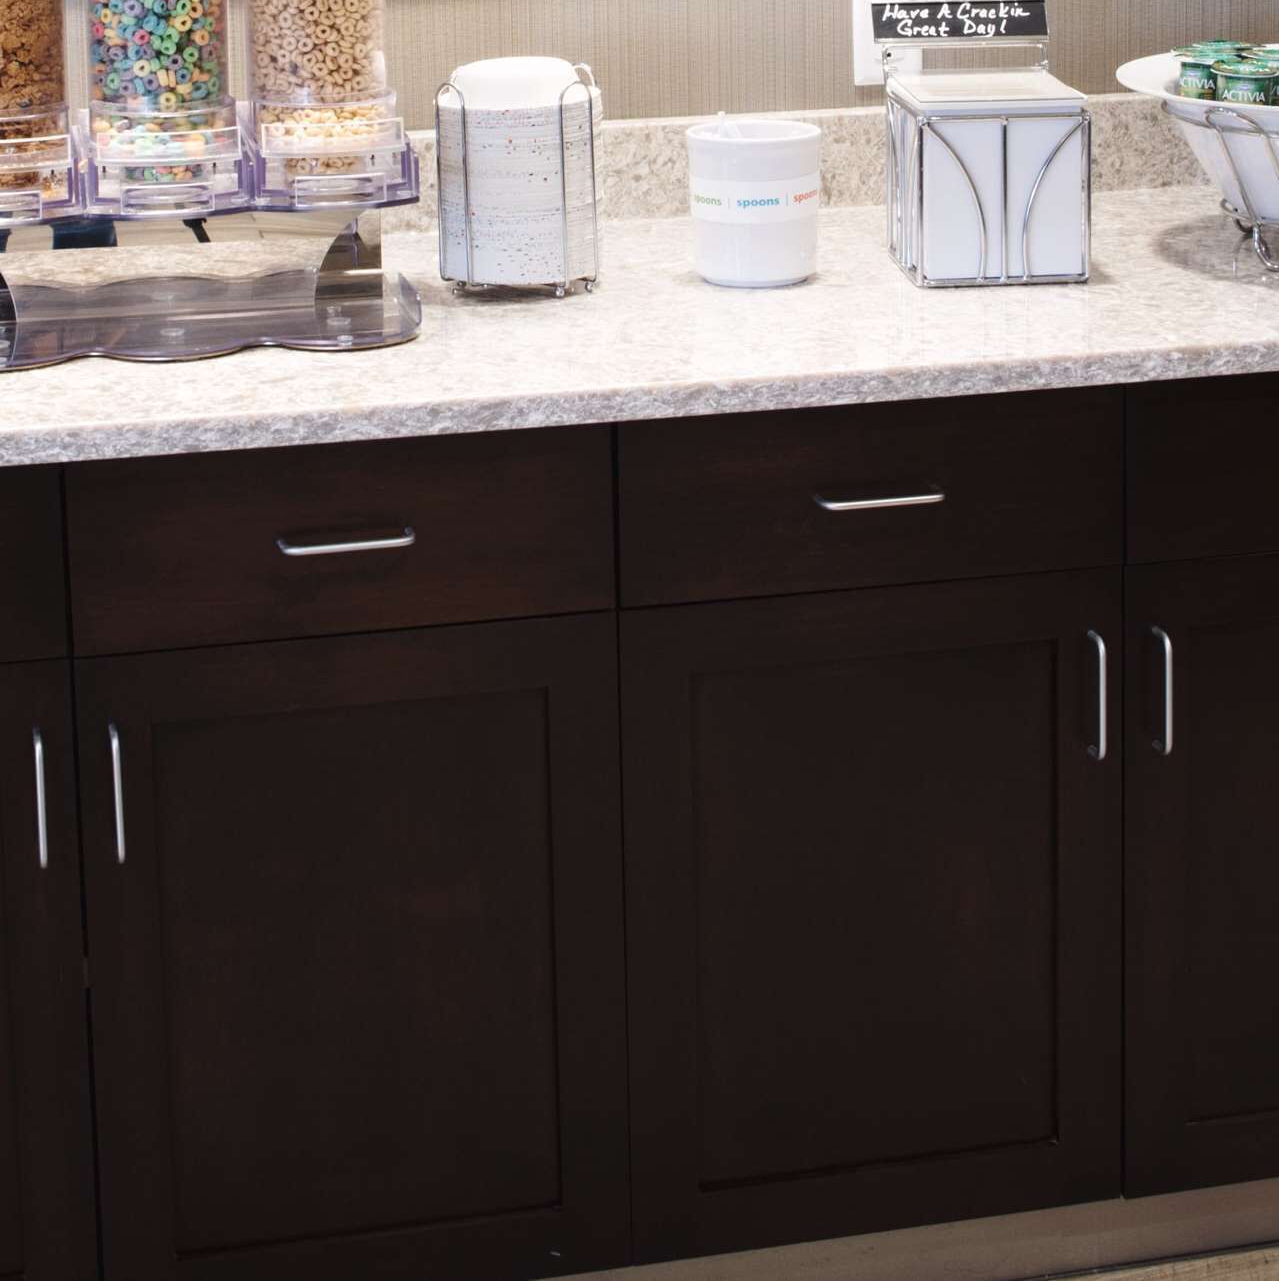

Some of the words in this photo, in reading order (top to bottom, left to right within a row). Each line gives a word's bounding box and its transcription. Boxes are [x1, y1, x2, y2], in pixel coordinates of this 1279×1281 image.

[882, 3, 929, 22] Have
[937, 3, 953, 19] A
[896, 19, 950, 37] Great
[963, 19, 1007, 38] Day!
[1221, 88, 1266, 103] ACTIVIA
[736, 196, 781, 210] spoons
